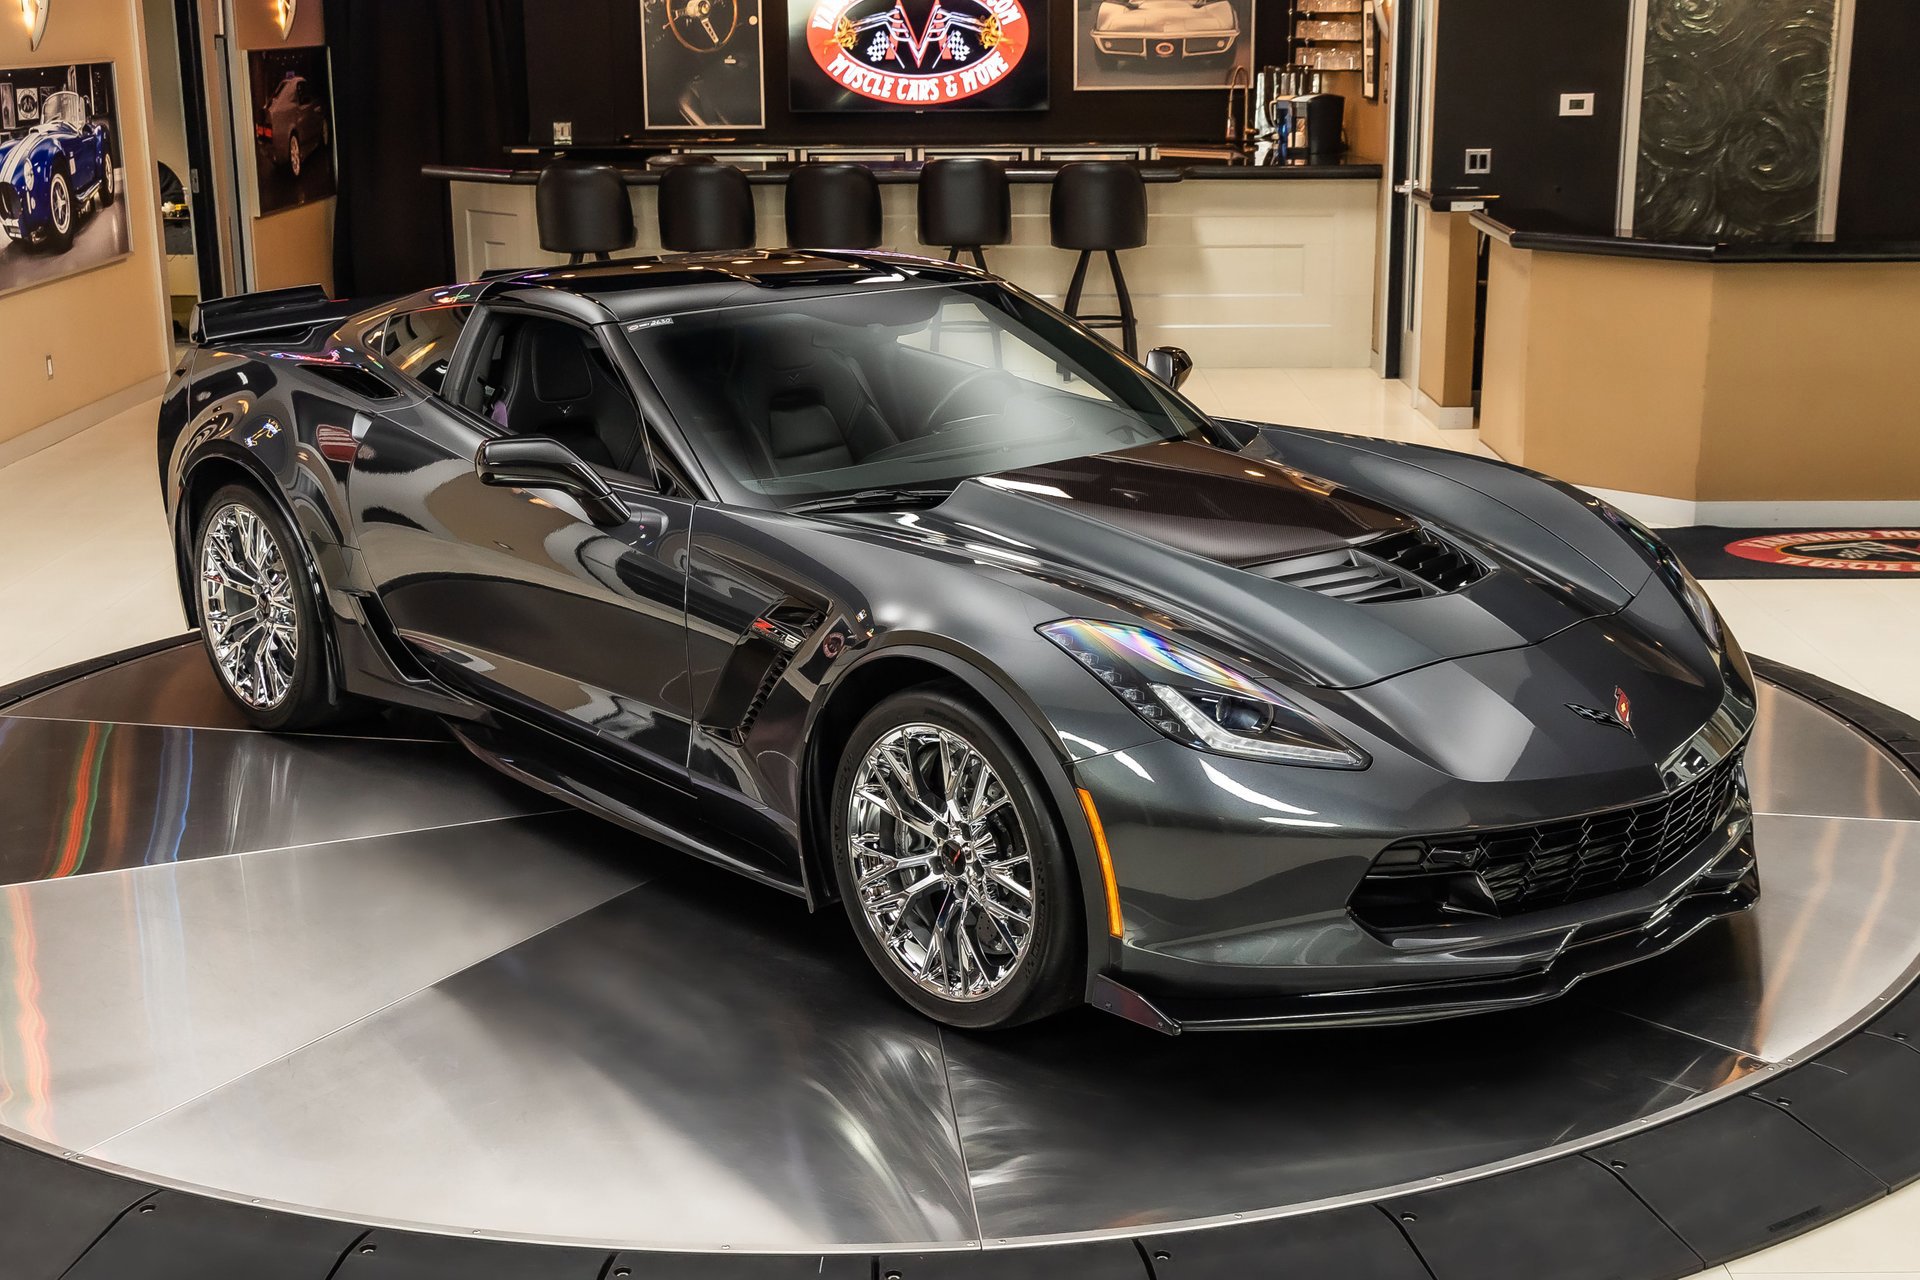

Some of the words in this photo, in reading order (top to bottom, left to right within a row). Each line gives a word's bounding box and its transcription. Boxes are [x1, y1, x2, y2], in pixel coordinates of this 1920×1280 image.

[826, 53, 895, 98] MUSCLE
[896, 78, 940, 101] CARS
[944, 75, 958, 97] &
[959, 51, 1009, 93] MORE
[1776, 557, 1901, 571] MUSCLE
